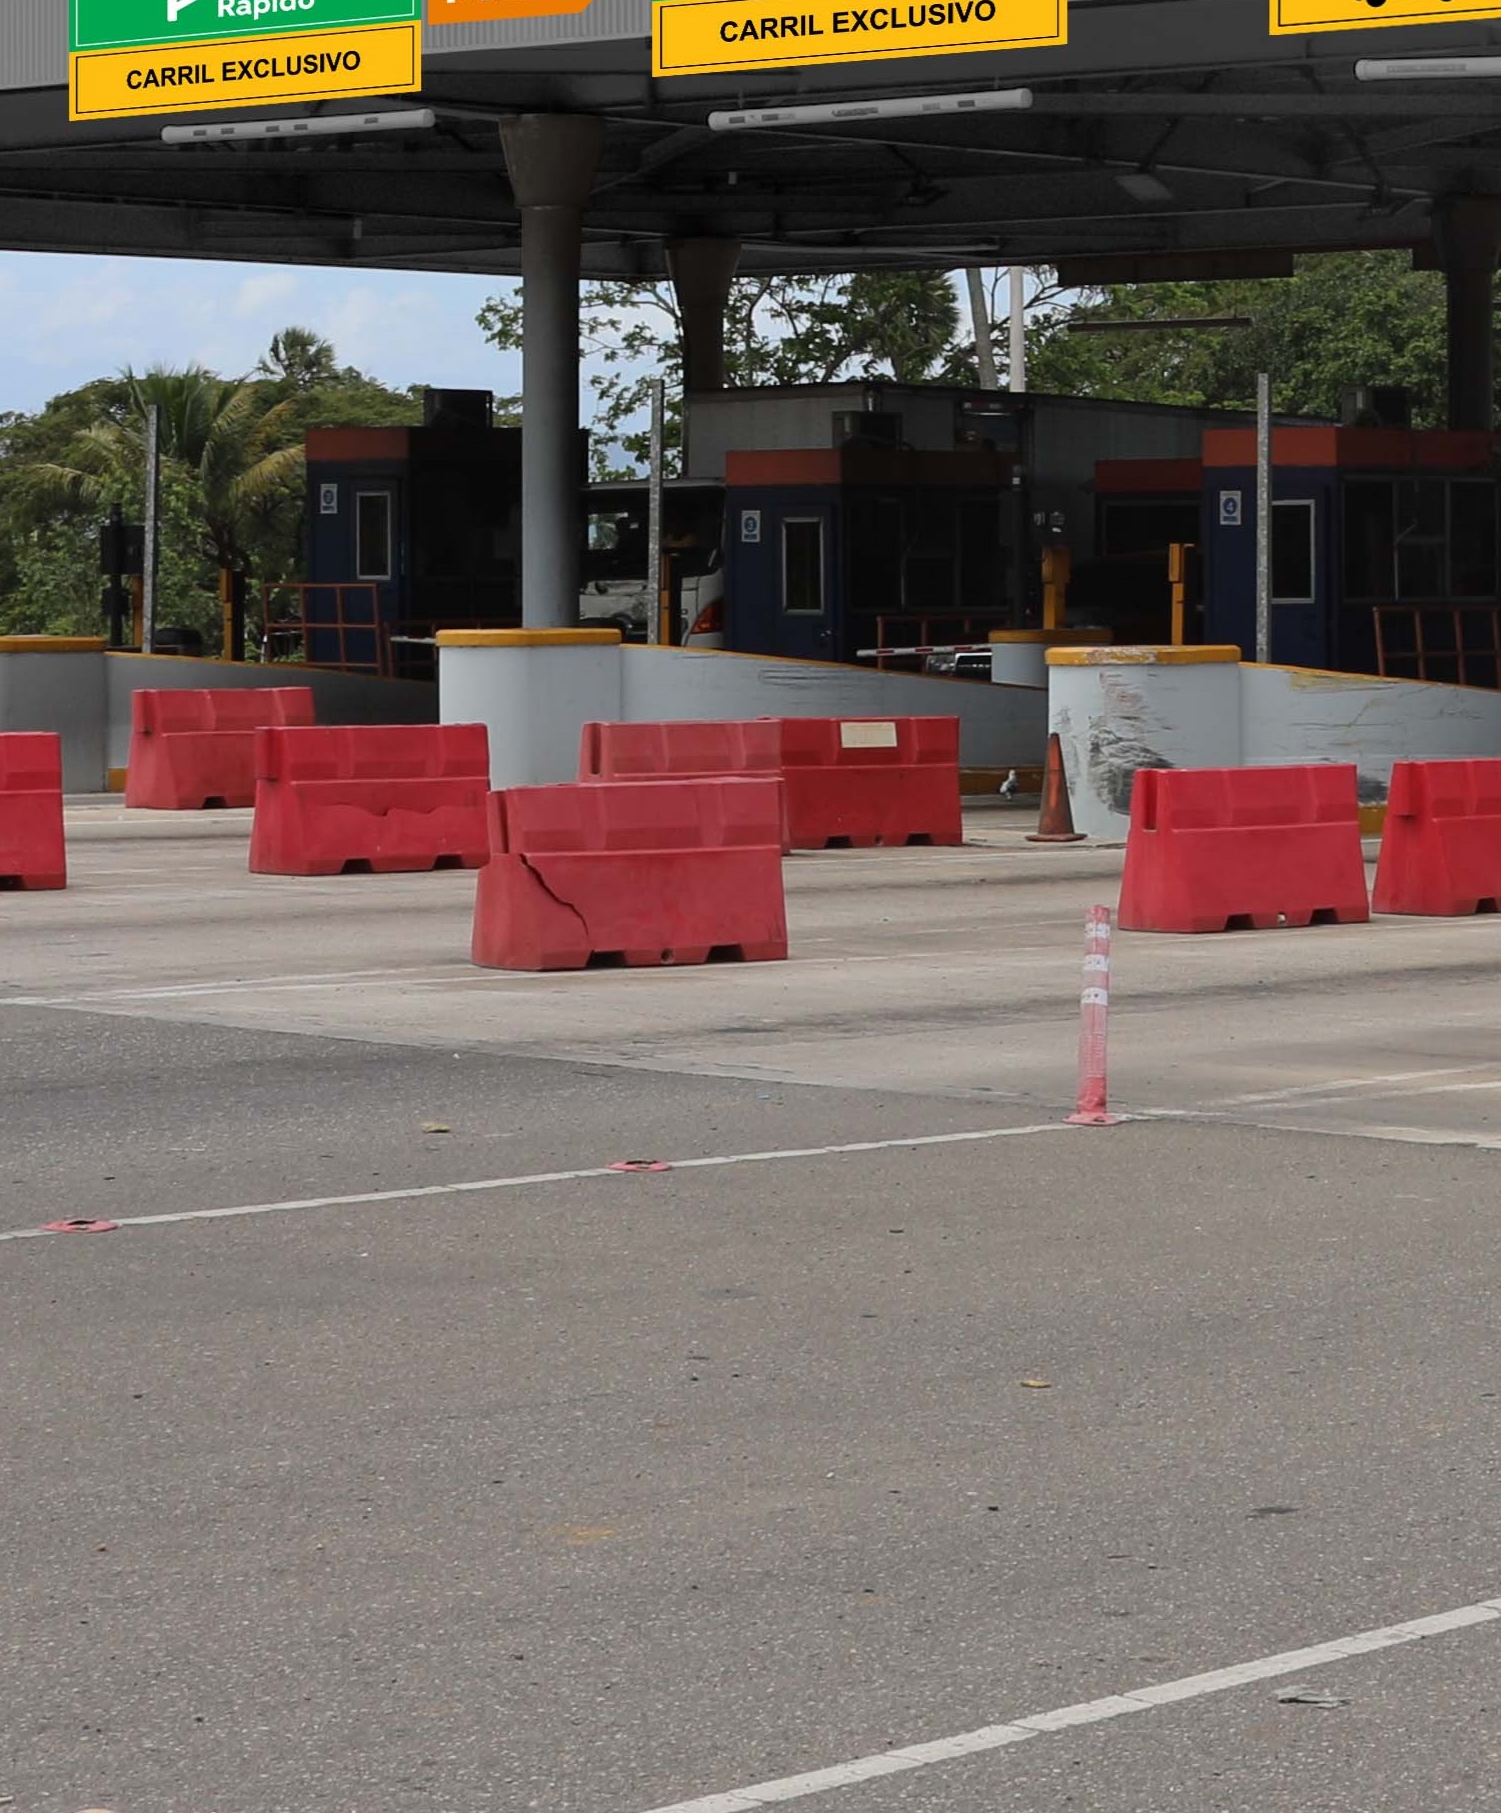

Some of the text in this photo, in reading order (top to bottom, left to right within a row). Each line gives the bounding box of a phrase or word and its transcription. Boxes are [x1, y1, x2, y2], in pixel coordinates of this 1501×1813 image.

[719, 0, 996, 43] CARRIL EXCLUSIVO
[126, 50, 361, 90] CARRIL EXCLUSIVO
